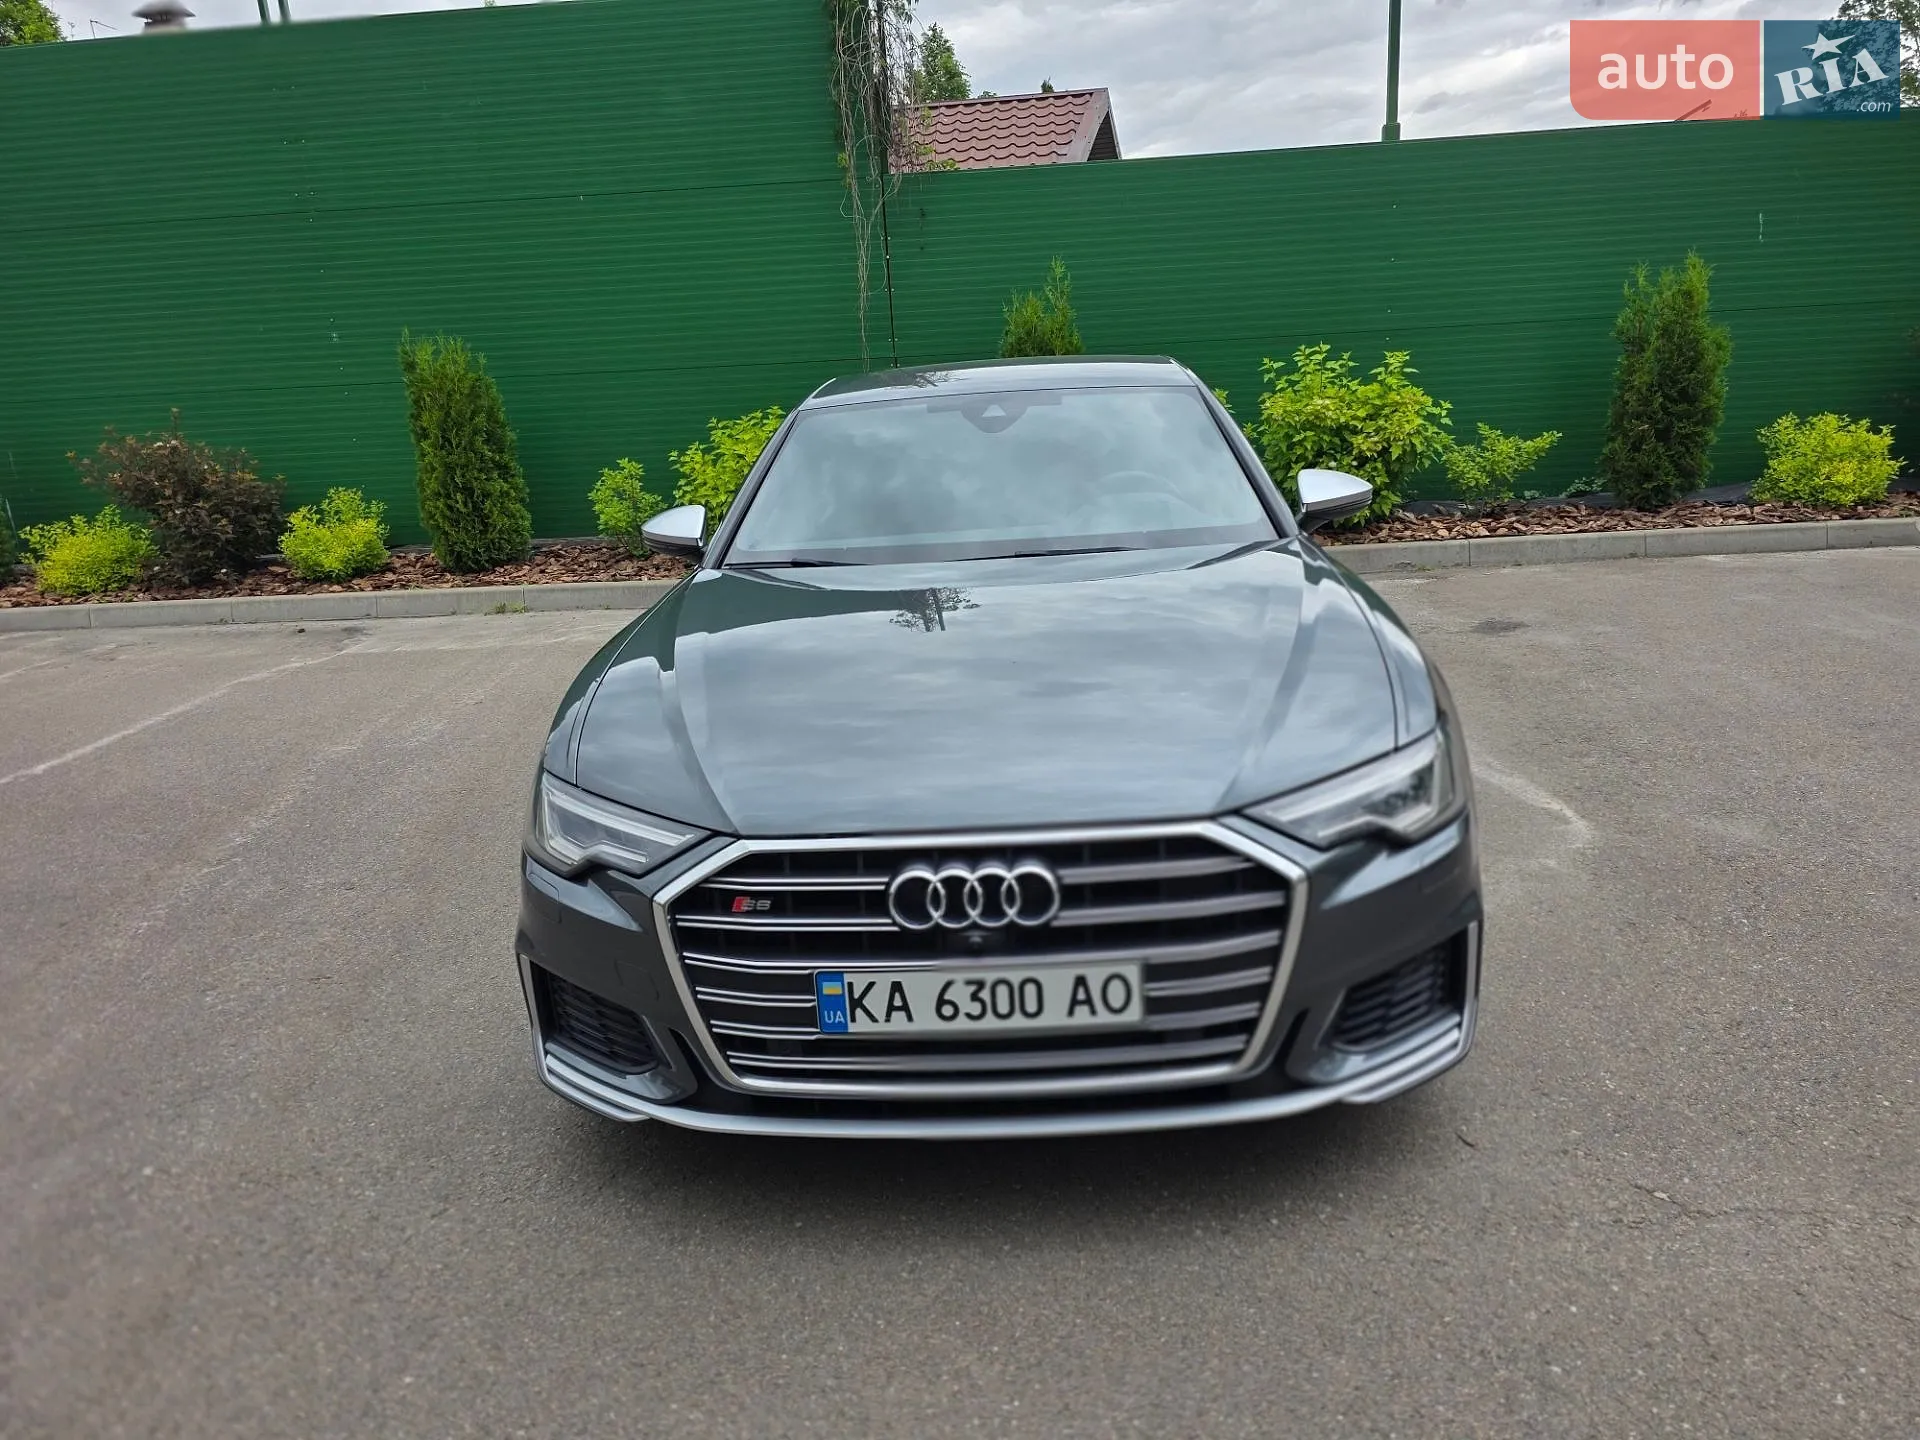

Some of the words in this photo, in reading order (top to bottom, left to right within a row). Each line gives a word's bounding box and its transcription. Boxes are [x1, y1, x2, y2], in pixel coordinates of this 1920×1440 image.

[846, 980, 915, 1024] KA
[935, 976, 1045, 1022] 6300
[1066, 973, 1133, 1018] AO
[824, 1009, 846, 1025] UA
